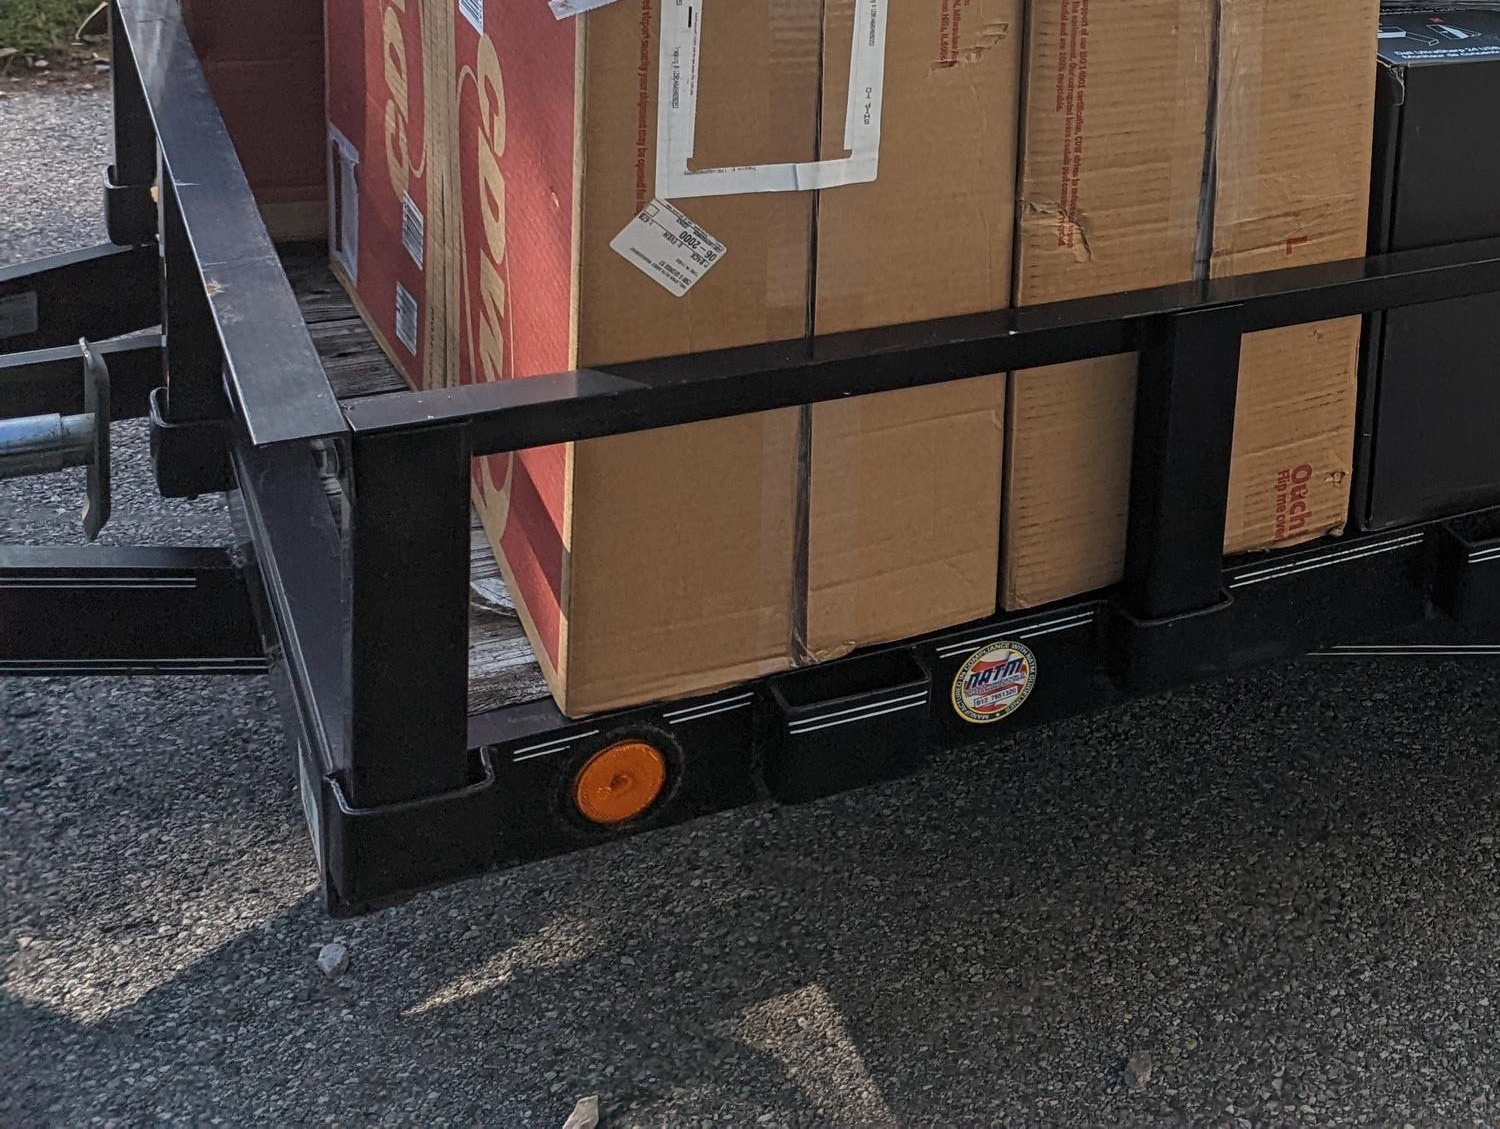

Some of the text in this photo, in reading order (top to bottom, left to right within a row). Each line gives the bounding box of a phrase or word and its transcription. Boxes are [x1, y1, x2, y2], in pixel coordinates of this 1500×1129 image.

[476, 33, 507, 387] CDW
[1275, 470, 1291, 492] Flip
[1276, 494, 1288, 513] me
